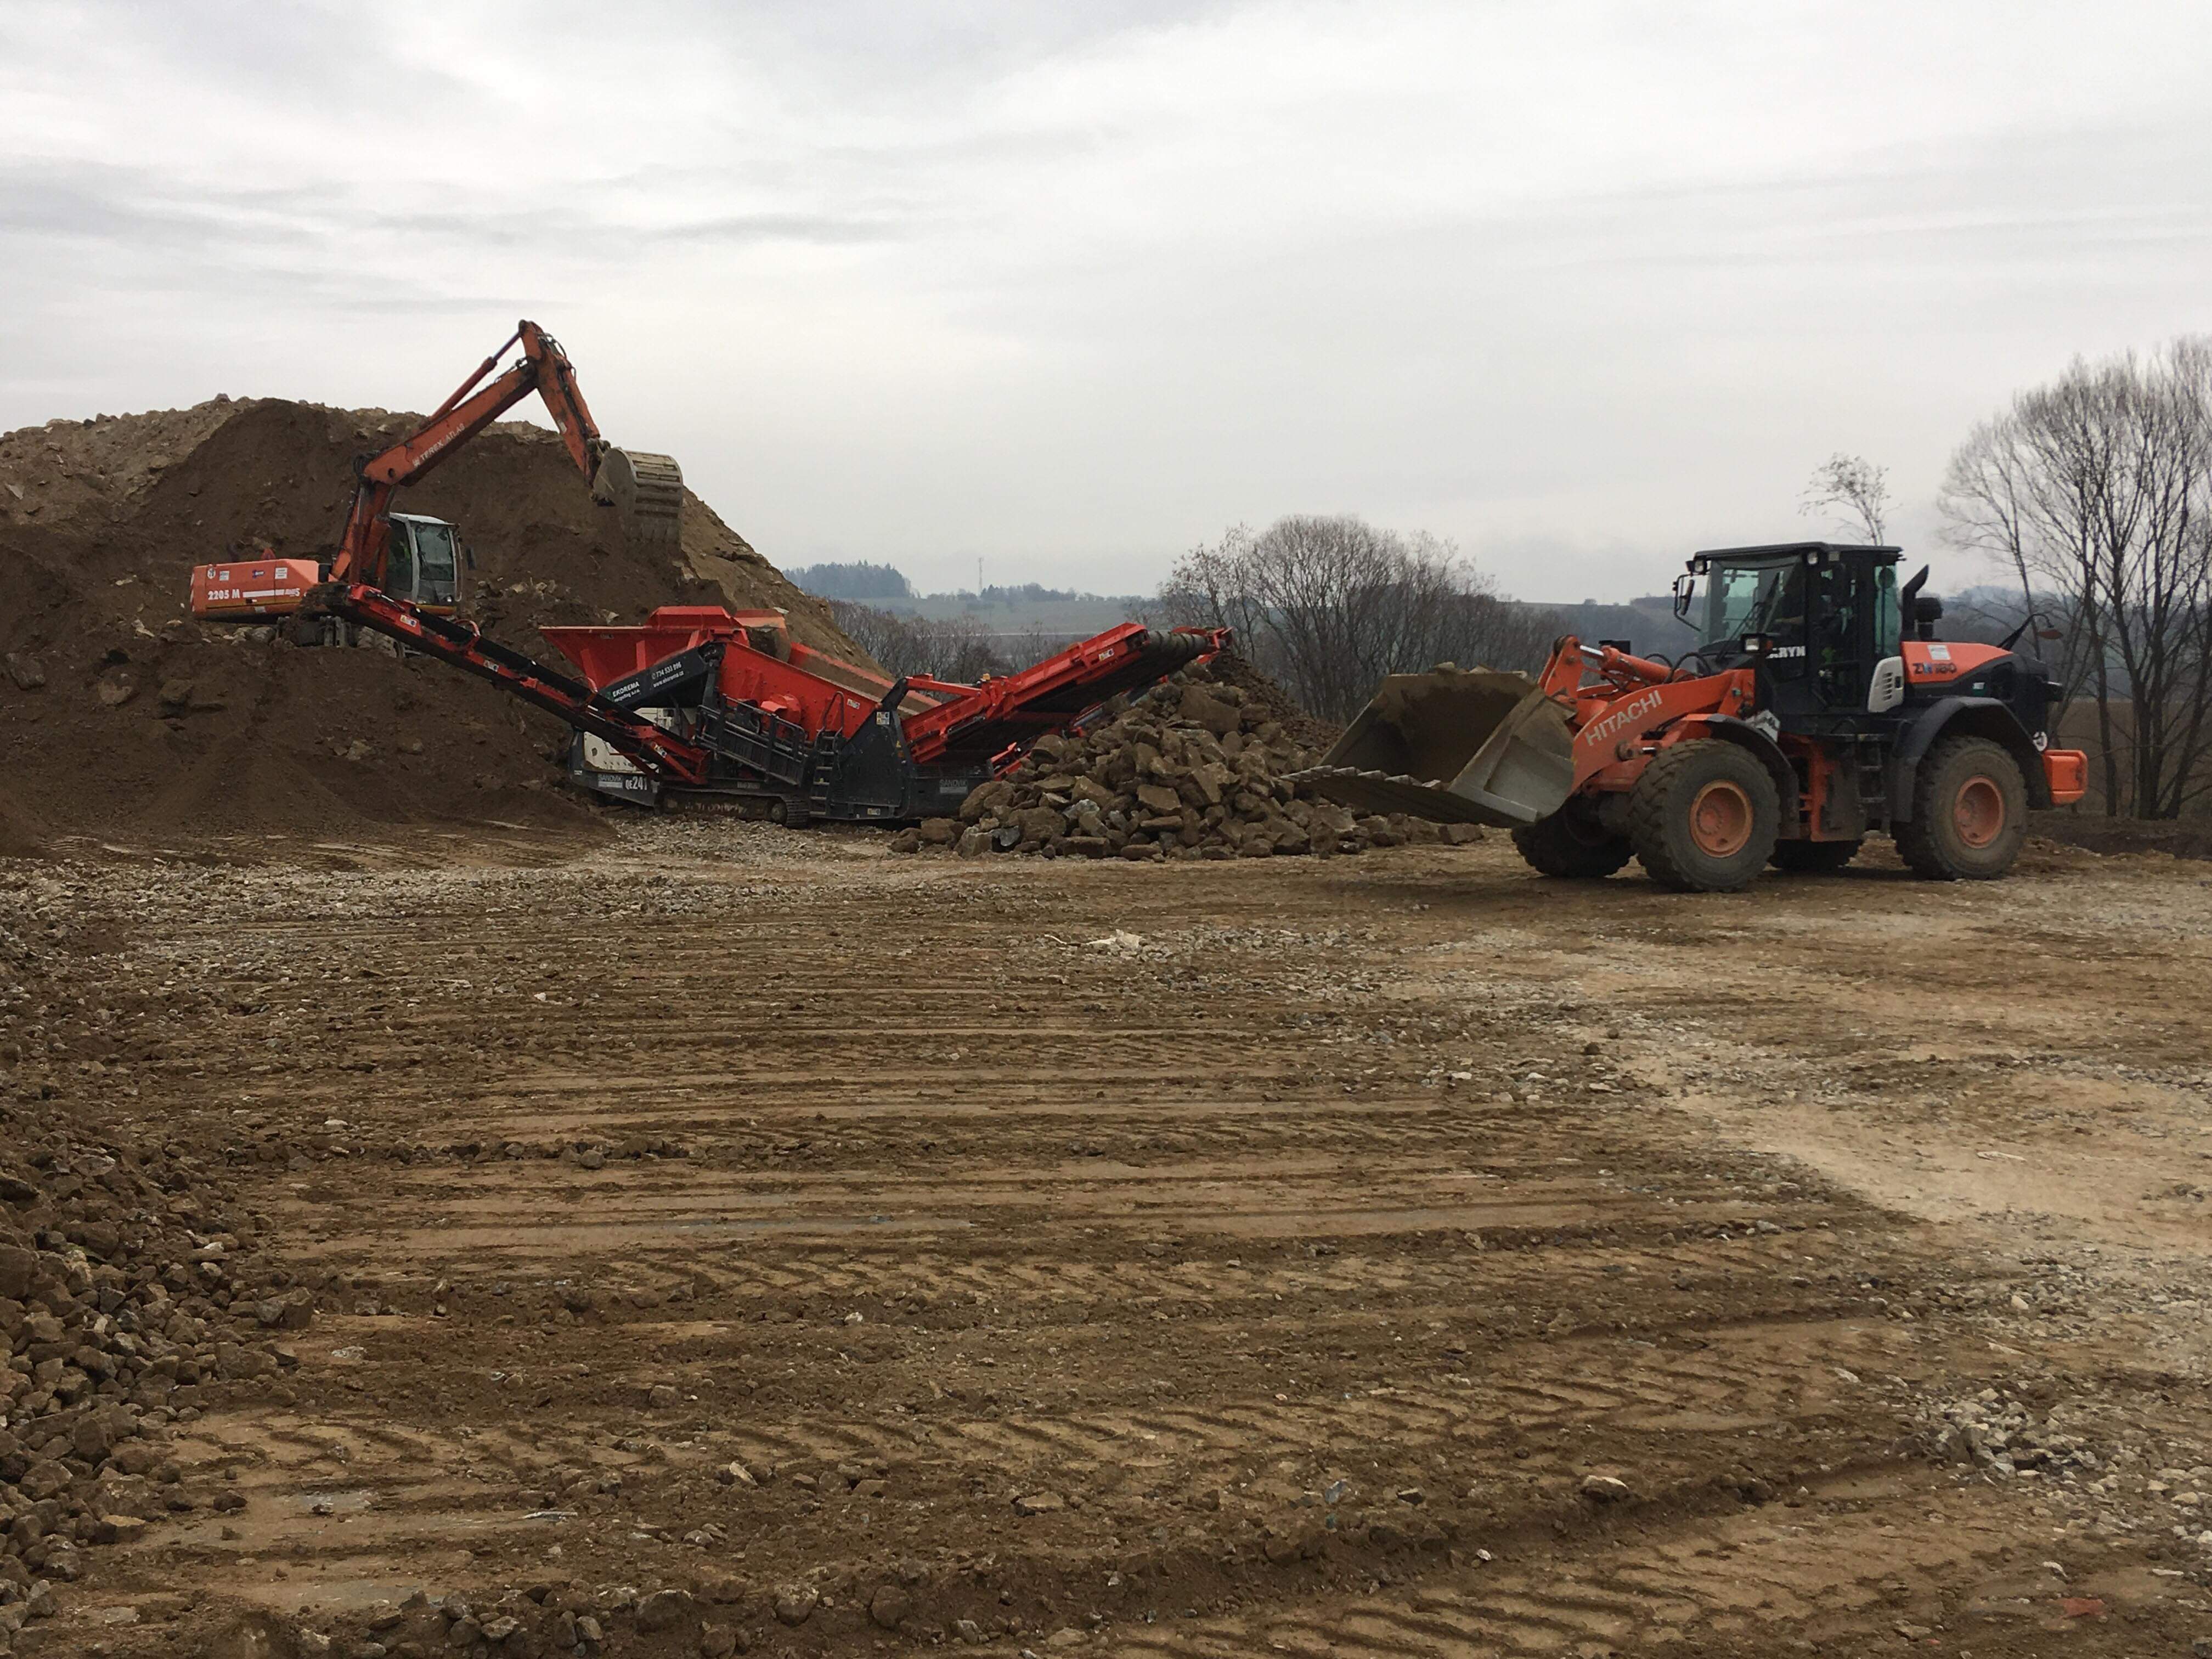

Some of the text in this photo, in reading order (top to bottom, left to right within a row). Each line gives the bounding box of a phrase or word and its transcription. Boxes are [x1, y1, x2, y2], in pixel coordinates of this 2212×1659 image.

[420, 423, 465, 460] TEREX ATLAS
[208, 589, 240, 600] 2205 M
[612, 681, 640, 697] EKOREMA
[1584, 690, 1662, 746] HITACHI
[625, 776, 647, 790] QE241
